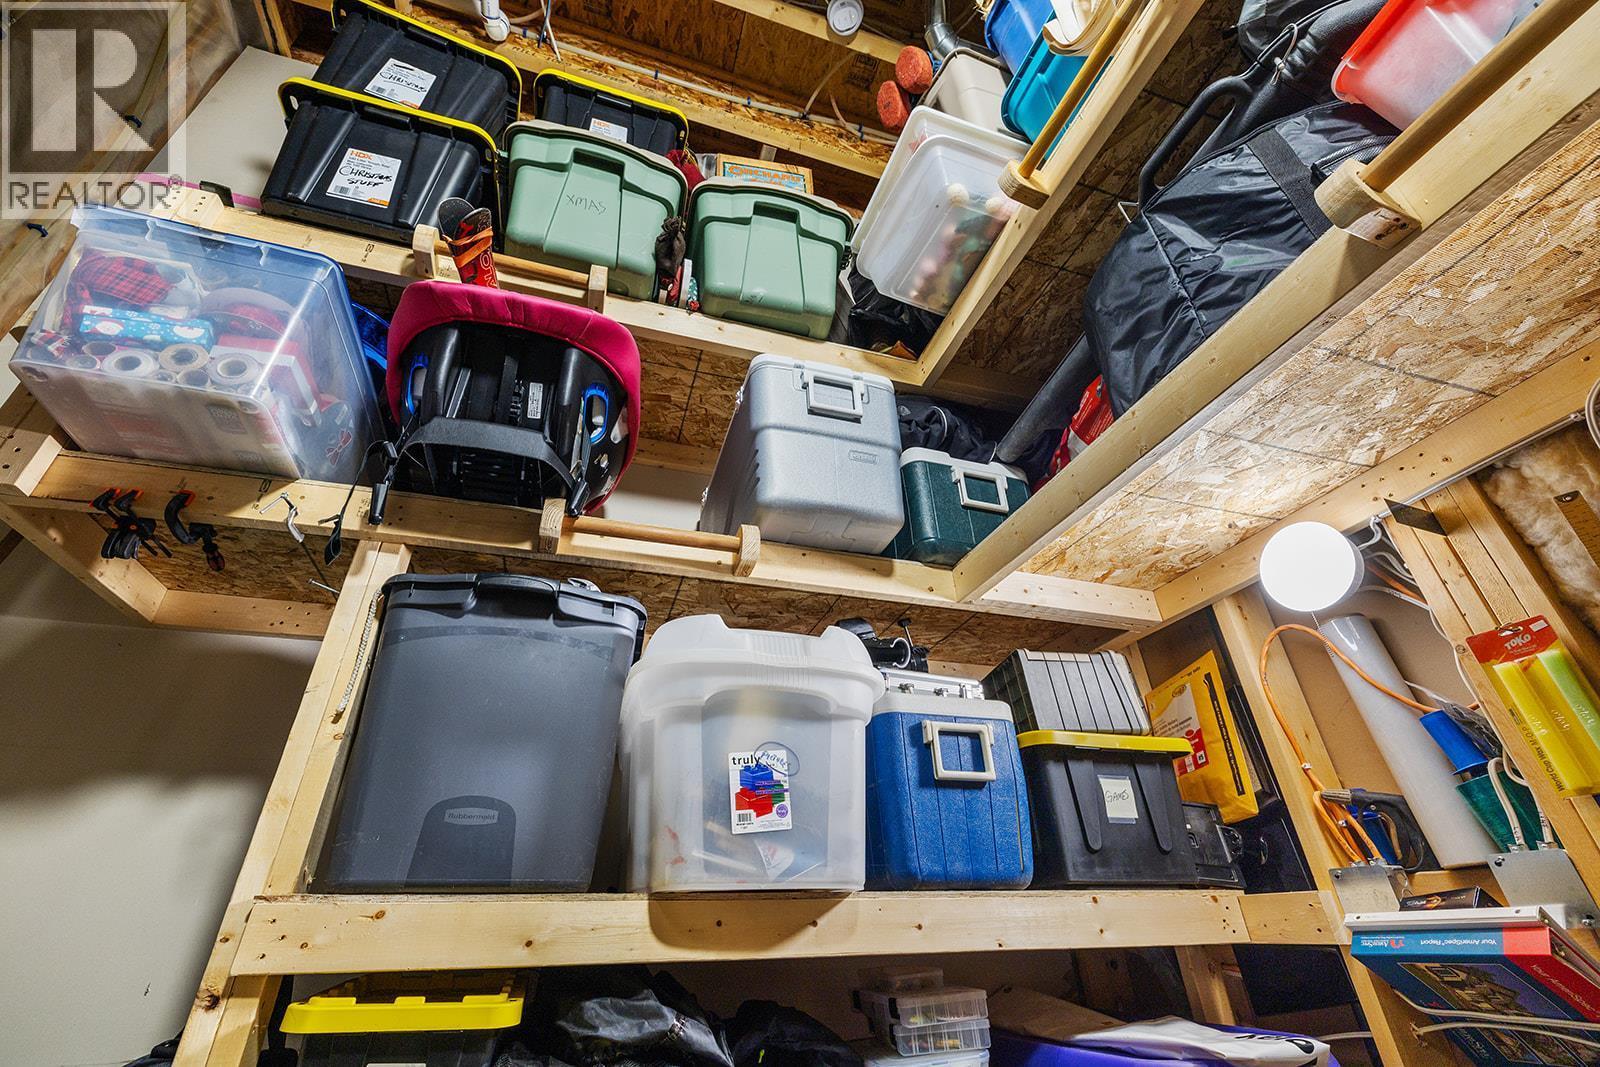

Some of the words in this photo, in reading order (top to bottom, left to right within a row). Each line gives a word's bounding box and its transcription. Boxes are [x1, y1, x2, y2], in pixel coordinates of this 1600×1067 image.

[566, 194, 607, 215] XMAS
[1536, 746, 1547, 761] Wax
[731, 754, 761, 767] truly
[1543, 760, 1554, 773] Cup
[1549, 773, 1566, 792] World
[448, 812, 496, 820] Rubbermaid
[1420, 938, 1440, 946] Report
